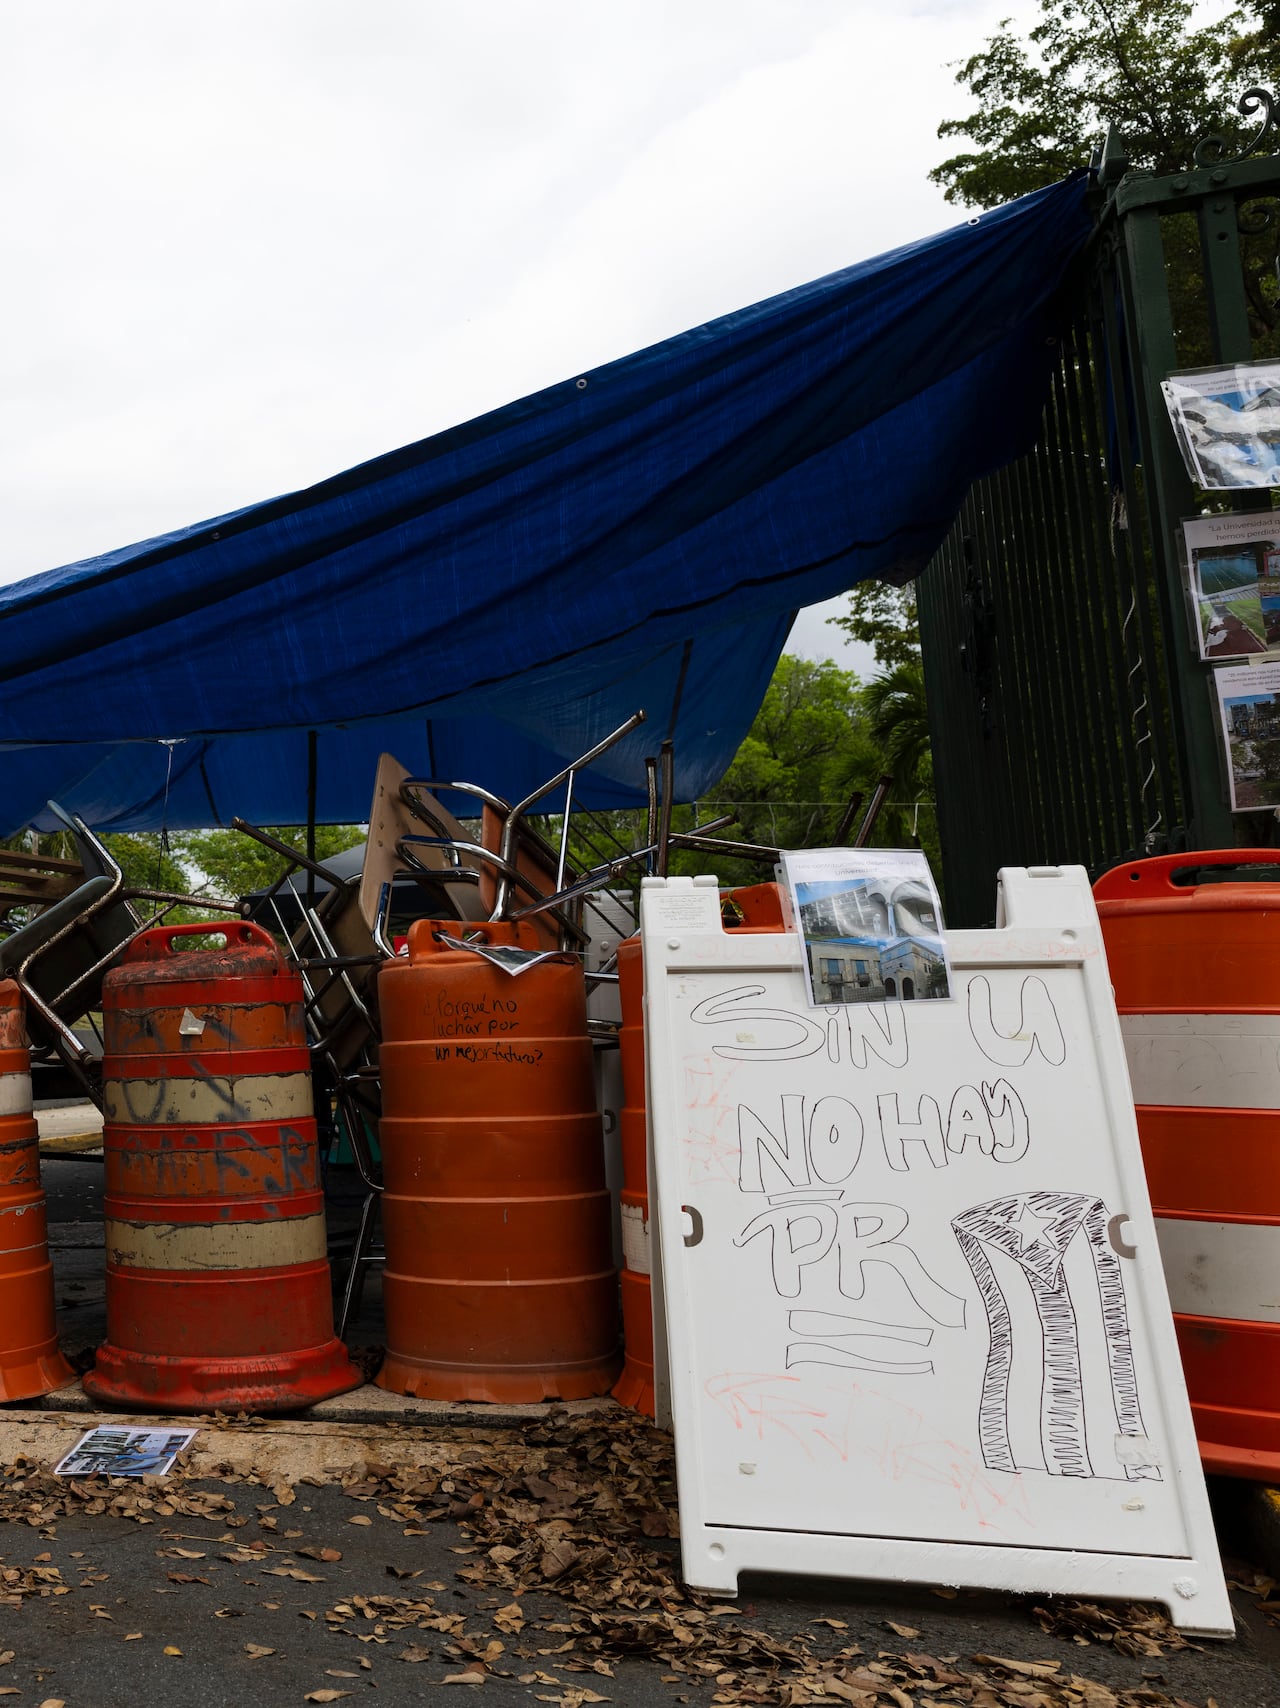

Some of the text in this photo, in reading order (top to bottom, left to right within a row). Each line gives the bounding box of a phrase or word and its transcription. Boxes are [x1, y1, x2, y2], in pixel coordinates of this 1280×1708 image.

[1223, 518, 1273, 531] Universidad
[1216, 532, 1246, 542] hemos
[492, 999, 518, 1014] no
[432, 1019, 520, 1039] luchar por
[967, 975, 1067, 1067] U
[435, 1046, 450, 1061] un
[455, 1045, 489, 1063] mejor
[737, 1094, 864, 1193] NO
[731, 1201, 967, 1329] PR
